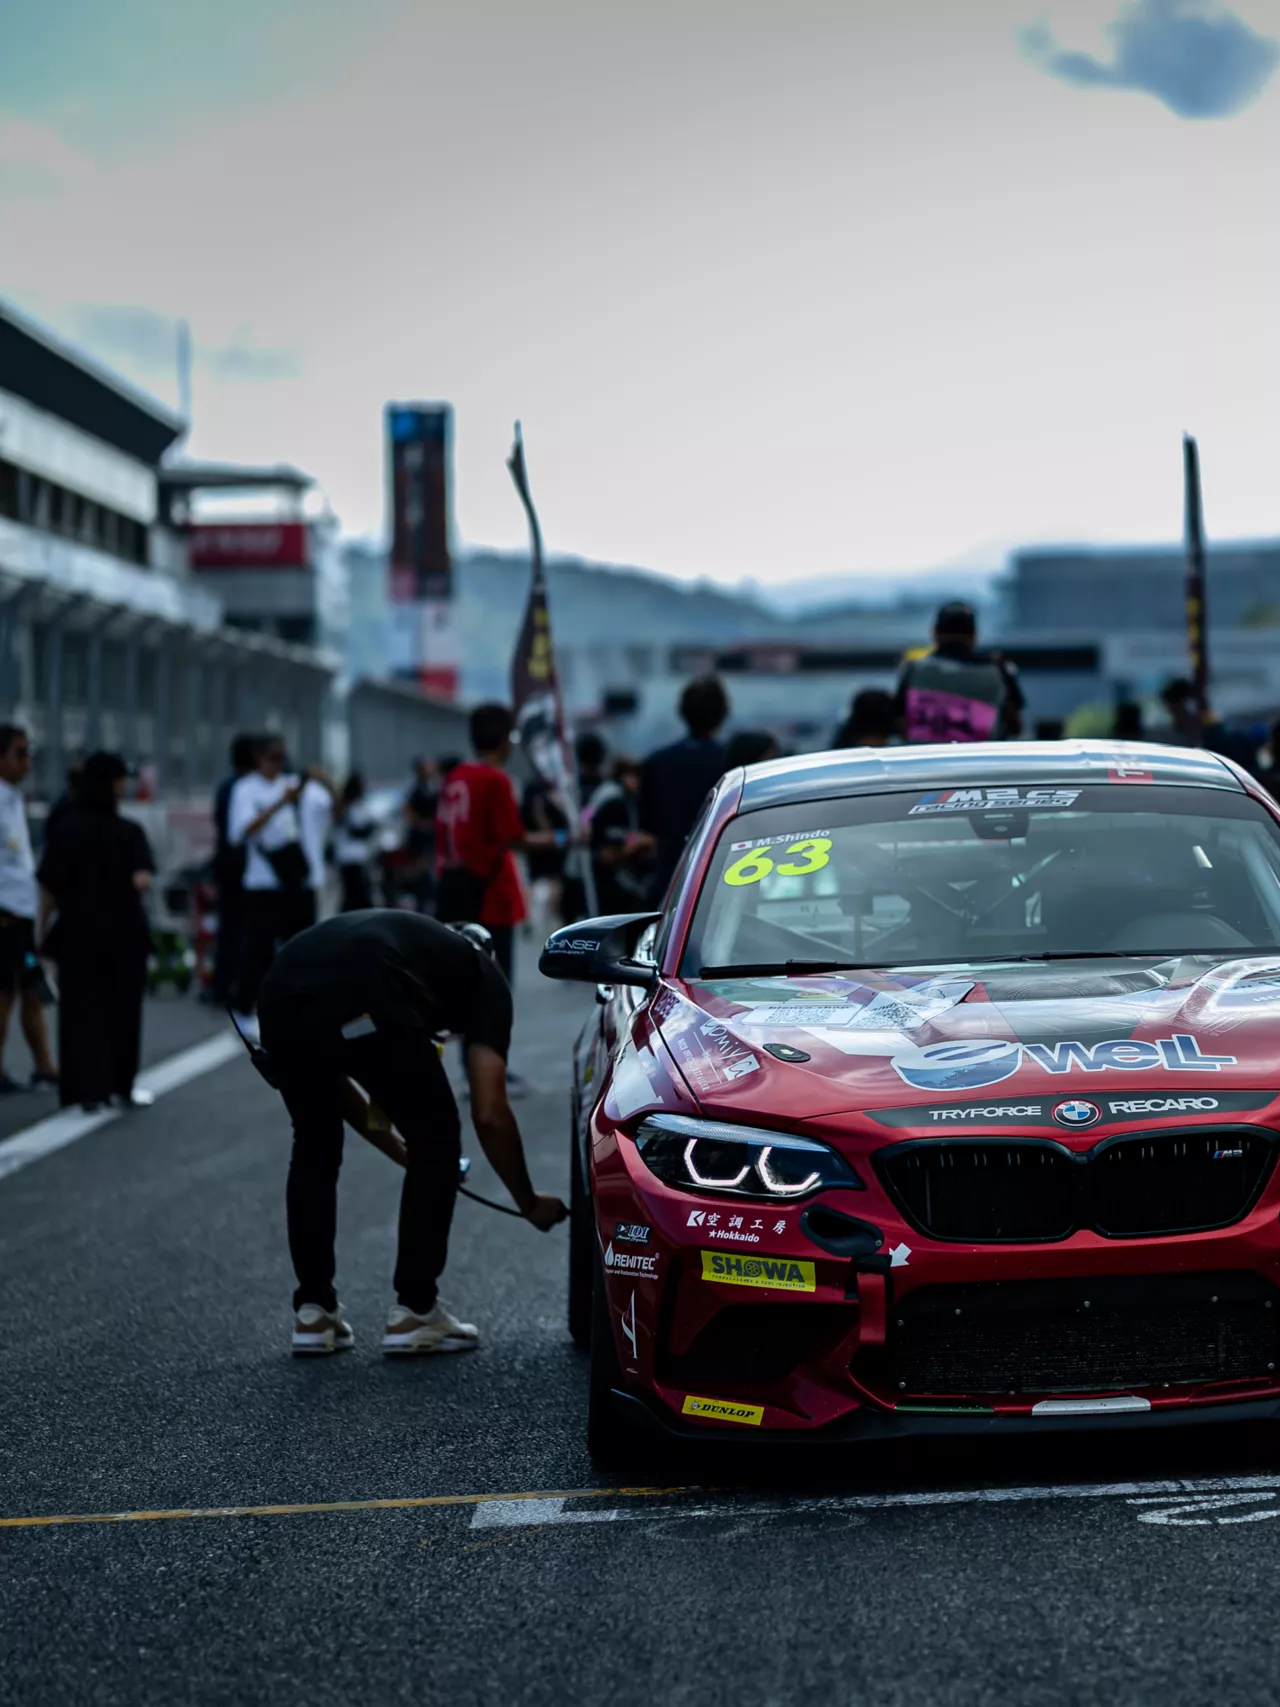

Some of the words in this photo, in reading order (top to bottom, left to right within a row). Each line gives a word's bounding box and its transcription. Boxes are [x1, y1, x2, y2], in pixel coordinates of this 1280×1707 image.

[755, 829, 831, 848] M.Shindo
[723, 838, 833, 886] 63
[929, 1106, 1041, 1121] TRYFORCE
[1110, 1097, 1219, 1115] RECARO
[705, 1213, 788, 1235] 空調工房
[717, 1230, 760, 1243] Hokkaido
[614, 1253, 656, 1270] REWITEC
[712, 1256, 804, 1283] SHOWA
[701, 1404, 755, 1418] DUNLOP
